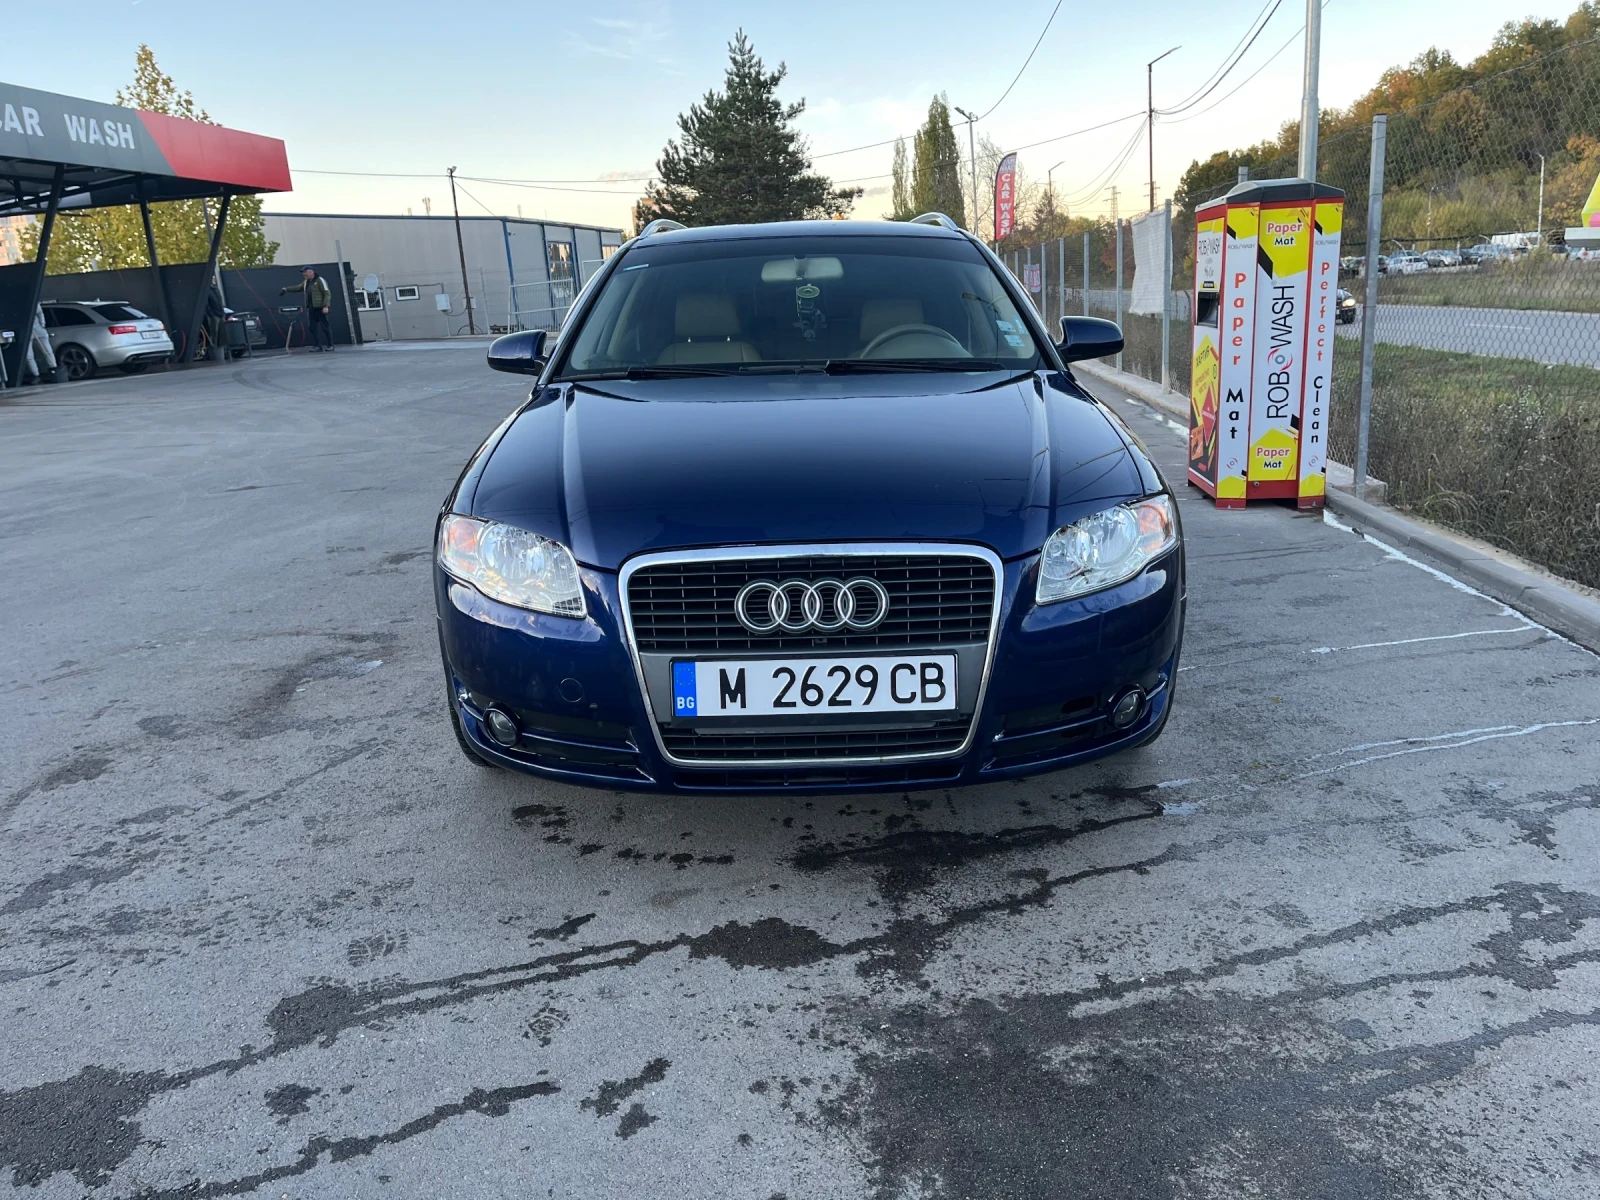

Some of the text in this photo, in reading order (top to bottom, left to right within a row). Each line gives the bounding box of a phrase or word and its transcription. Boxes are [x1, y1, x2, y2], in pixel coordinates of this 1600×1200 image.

[0, 103, 135, 149] AR WASH
[1001, 173, 1011, 199] CAR
[1000, 202, 1012, 236] WASH
[1267, 222, 1303, 235] Paper
[1274, 236, 1294, 246] Mat
[1226, 272, 1247, 439] Paper Mat
[1311, 261, 1330, 443] Perfect Clean
[1256, 447, 1290, 459] Paper
[1263, 460, 1282, 469] Mat
[719, 662, 946, 709] M 2629 CB
[676, 696, 695, 709] BG
